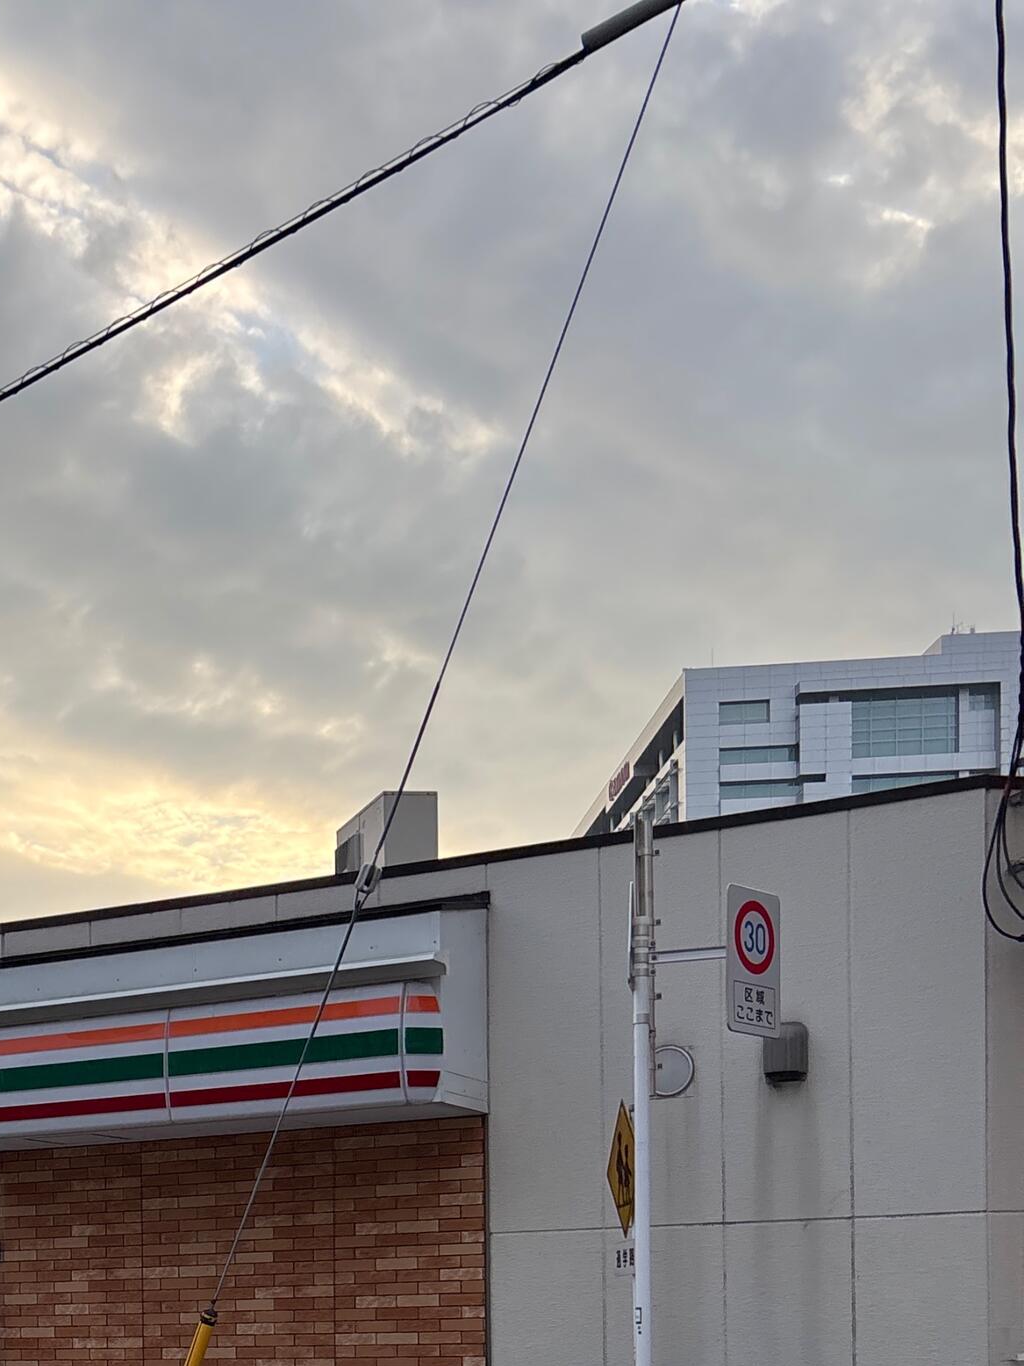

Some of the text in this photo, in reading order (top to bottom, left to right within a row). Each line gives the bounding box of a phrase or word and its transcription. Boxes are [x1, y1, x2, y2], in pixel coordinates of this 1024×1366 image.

[744, 920, 766, 955] 30
[744, 986, 765, 1006] 区域
[736, 1004, 774, 1026] ここまで
